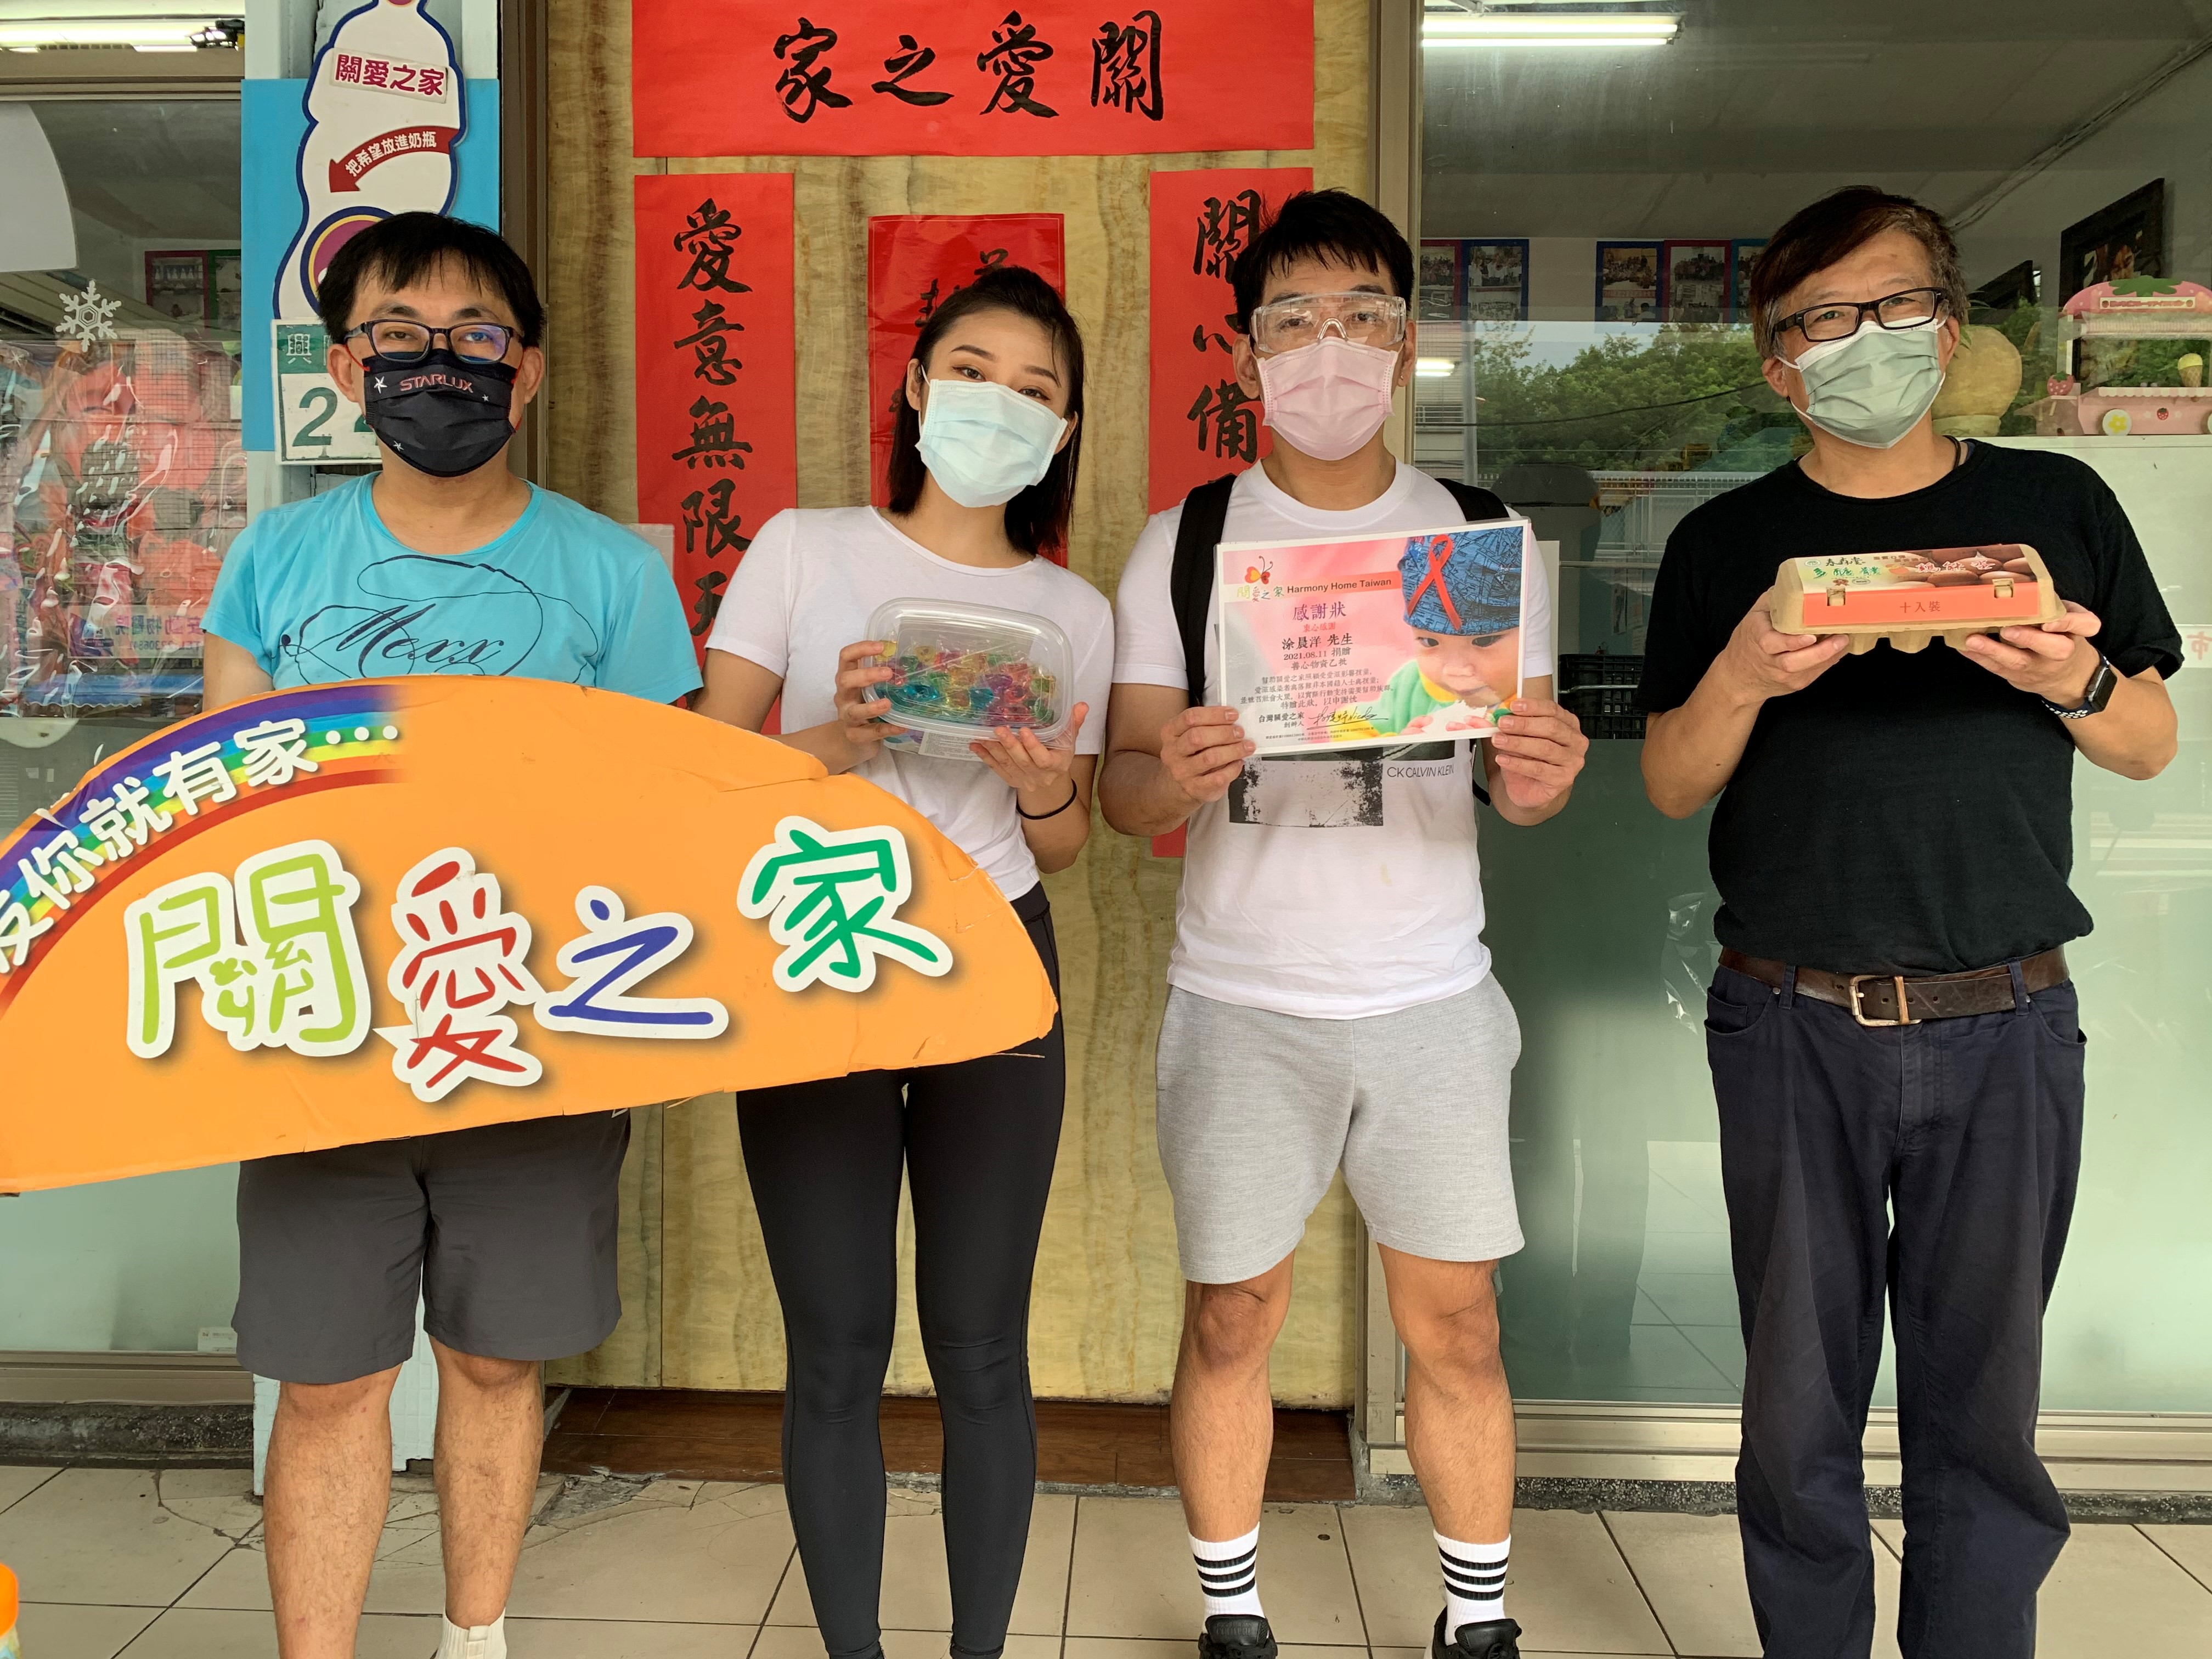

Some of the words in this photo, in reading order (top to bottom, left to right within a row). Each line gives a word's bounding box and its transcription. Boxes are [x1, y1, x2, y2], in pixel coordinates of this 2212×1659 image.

[335, 54, 444, 97] 關愛之家
[345, 130, 437, 177] 把希望放進奶瓶
[286, 333, 331, 366] 興
[399, 373, 474, 393] STARLUX
[1237, 585, 1285, 602] 關愛之家
[1287, 583, 1328, 594] Harmony
[1331, 582, 1357, 591] Home
[1359, 578, 1392, 588] Taiwan
[1292, 600, 1347, 622] 感謝狀
[1899, 600, 1941, 614] 十入裝
[1327, 633, 1353, 646] 先生
[1283, 650, 1327, 661] 2021.08.11
[1290, 657, 1347, 671] 善心物資乙批
[1259, 712, 1305, 724] 台灣關愛之家
[1387, 766, 1404, 778] CK
[1405, 766, 1437, 778] CALVIN
[1437, 763, 1454, 777] KLEIN
[127, 816, 955, 1099] 關愛之家
